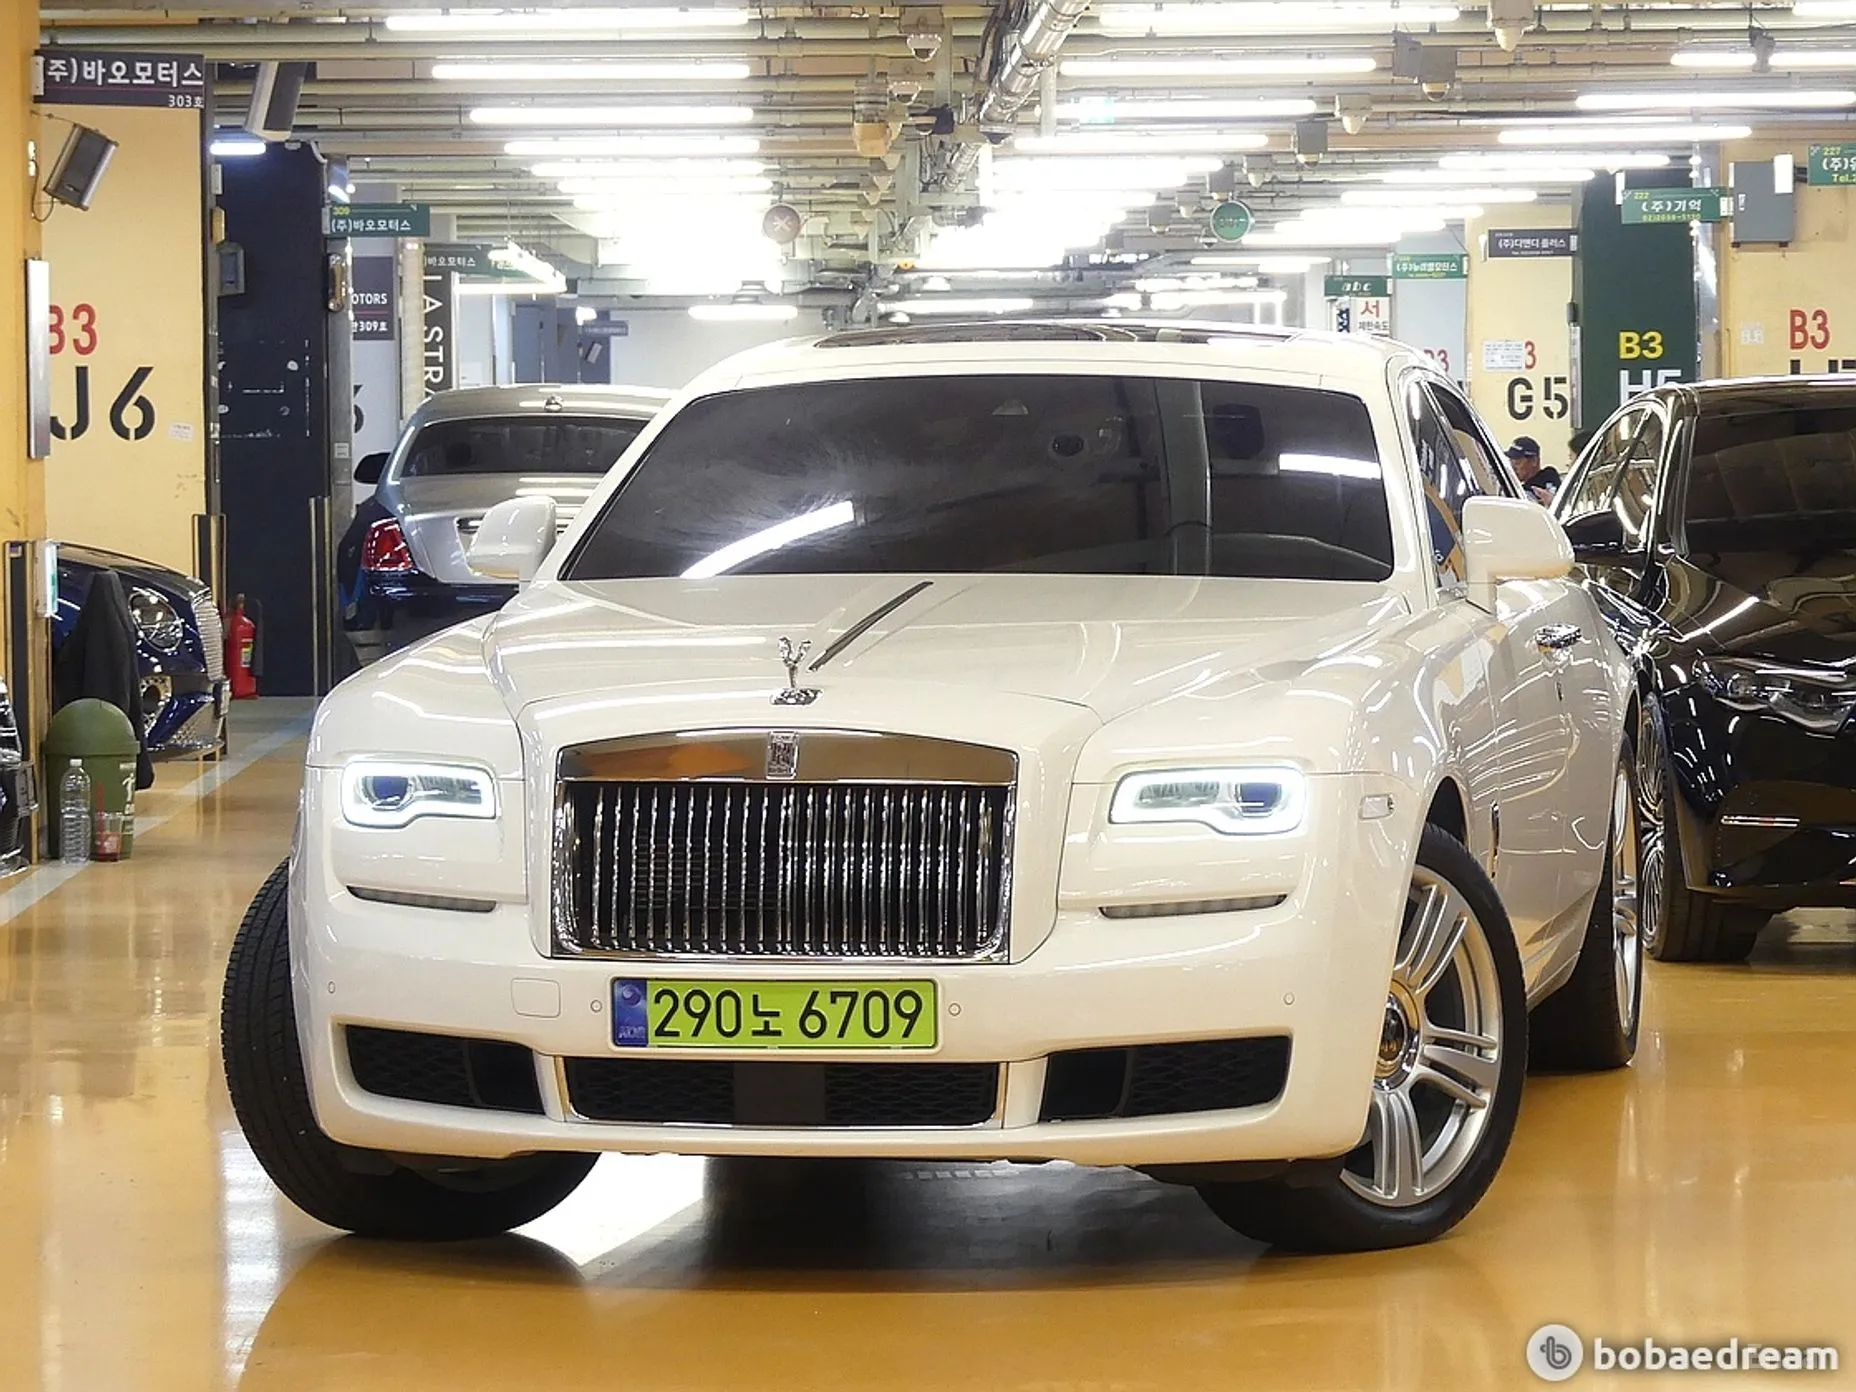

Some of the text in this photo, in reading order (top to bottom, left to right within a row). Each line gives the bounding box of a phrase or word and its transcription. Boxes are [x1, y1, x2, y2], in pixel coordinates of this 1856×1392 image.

[46, 57, 204, 87] 주)바오모터스
[168, 95, 204, 107] 303호
[331, 219, 411, 232] (주)바오모터스
[351, 293, 388, 305] OTORS
[1342, 281, 1372, 291] abc
[1789, 309, 1831, 350] B3
[1619, 331, 1664, 360] B3
[50, 365, 155, 441] J6
[1507, 376, 1569, 421] G5
[653, 988, 923, 1039] 290노 6709
